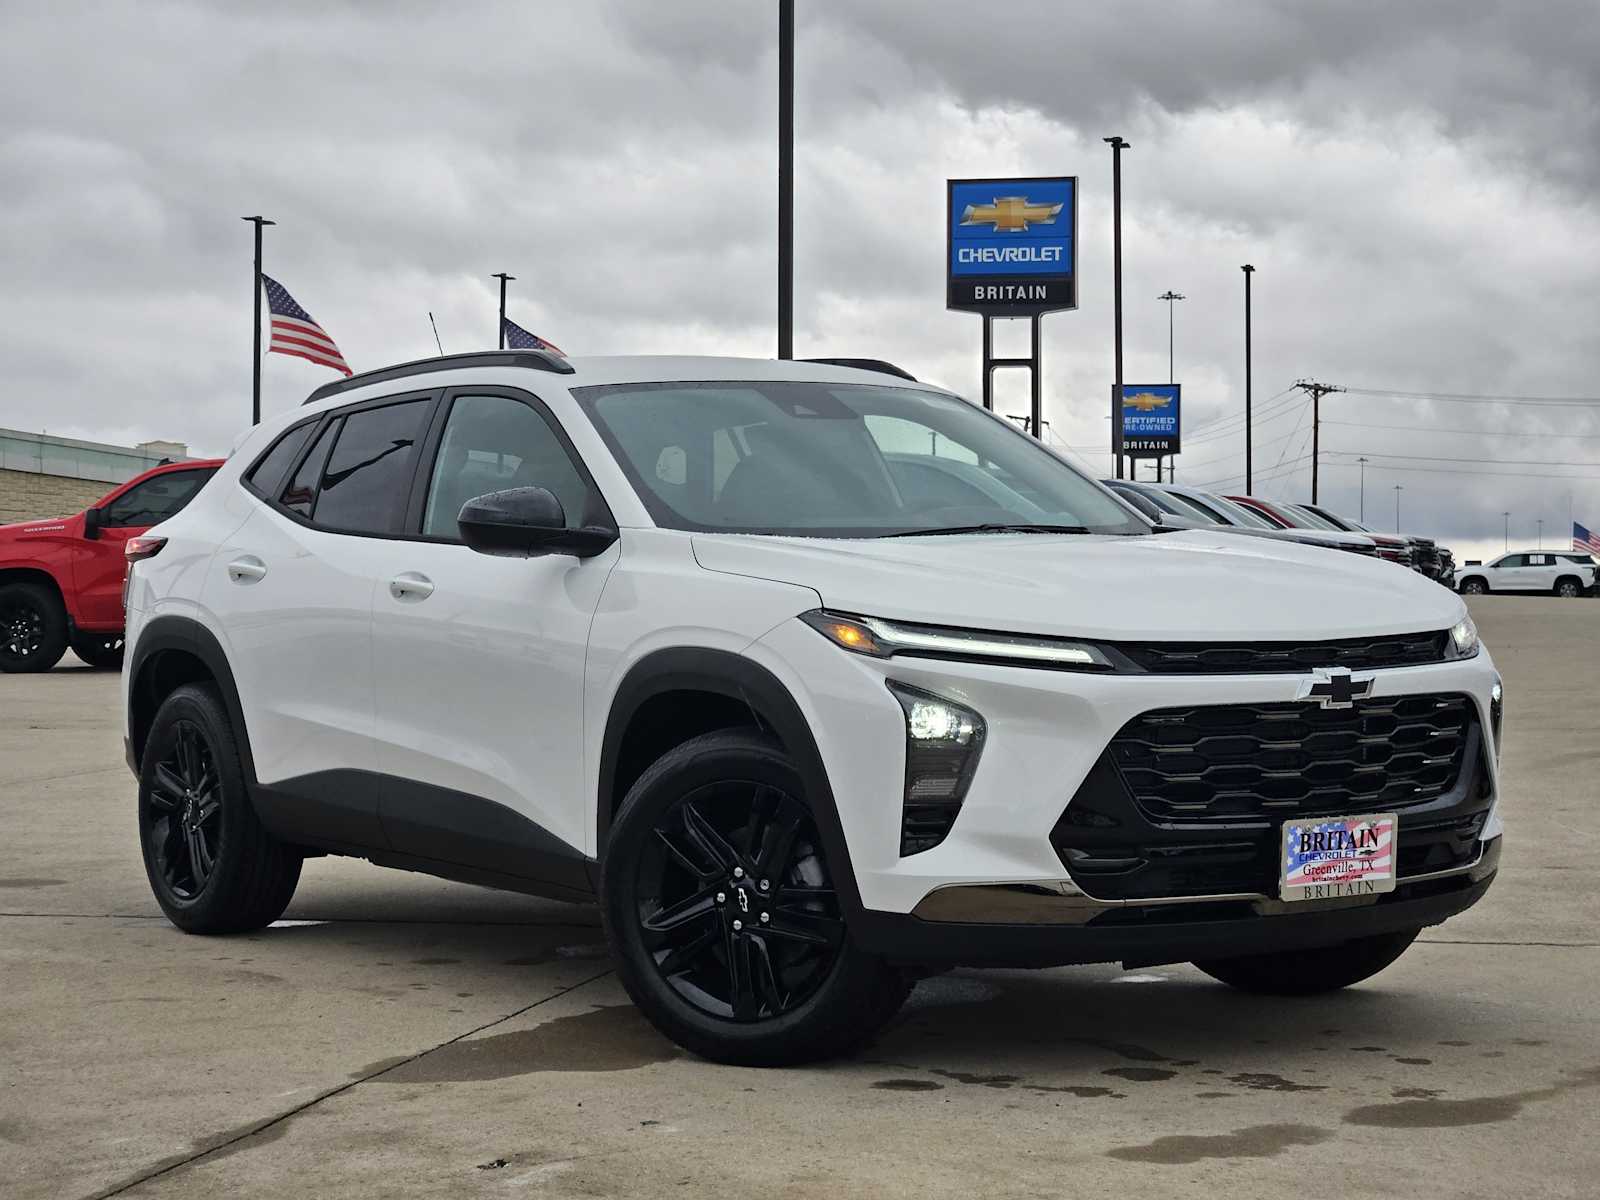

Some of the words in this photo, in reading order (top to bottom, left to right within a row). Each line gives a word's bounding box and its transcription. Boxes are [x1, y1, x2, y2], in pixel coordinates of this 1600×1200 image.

[958, 246, 1063, 263] CHEVROLET
[974, 285, 1047, 300] BRITAIN
[1124, 416, 1176, 424] ERTIFIED
[1122, 441, 1169, 450] BRITAIN
[1300, 828, 1379, 852] BRITAIN
[1298, 850, 1357, 862] CHEVROLET
[1303, 862, 1356, 876] Greenville,
[1360, 859, 1374, 872] TX
[1303, 880, 1375, 899] BRITAIN
